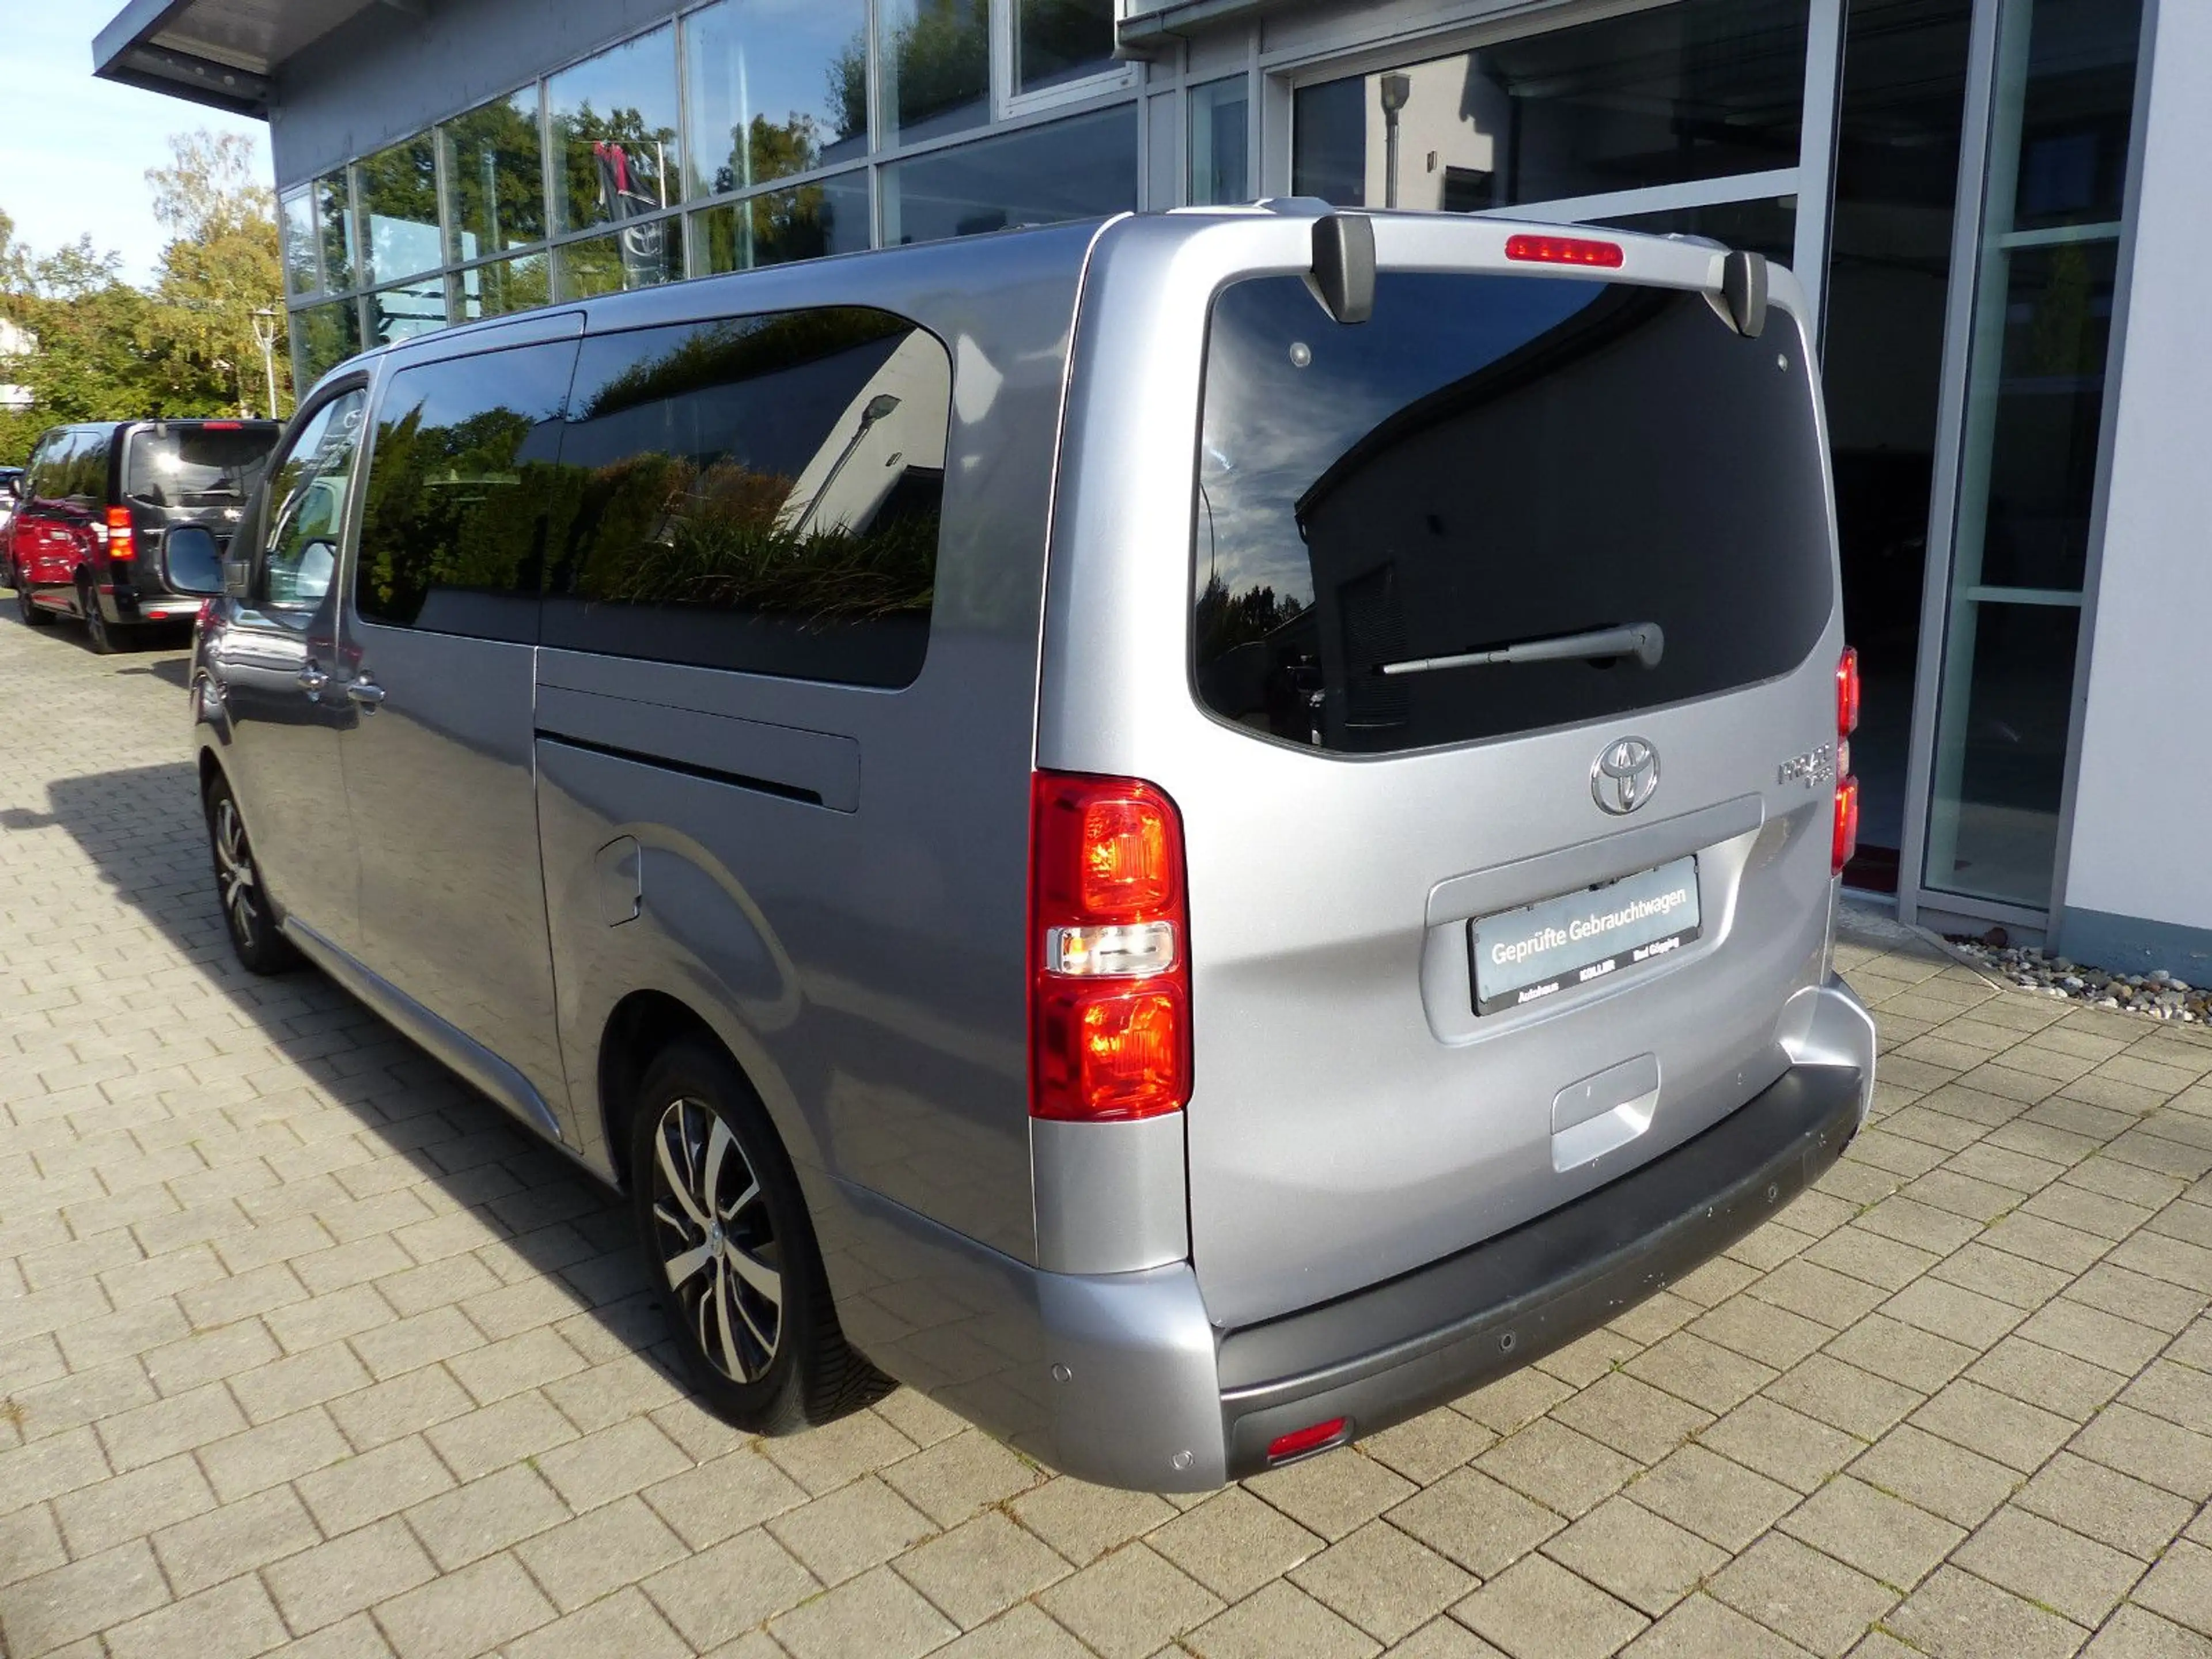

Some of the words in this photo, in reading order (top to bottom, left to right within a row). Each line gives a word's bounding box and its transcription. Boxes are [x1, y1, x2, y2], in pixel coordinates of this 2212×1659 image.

[1492, 929, 1567, 964] Geprüfte
[1569, 889, 1685, 940] Gebrauchtwagen
[1517, 982, 1559, 1003] Autohaus
